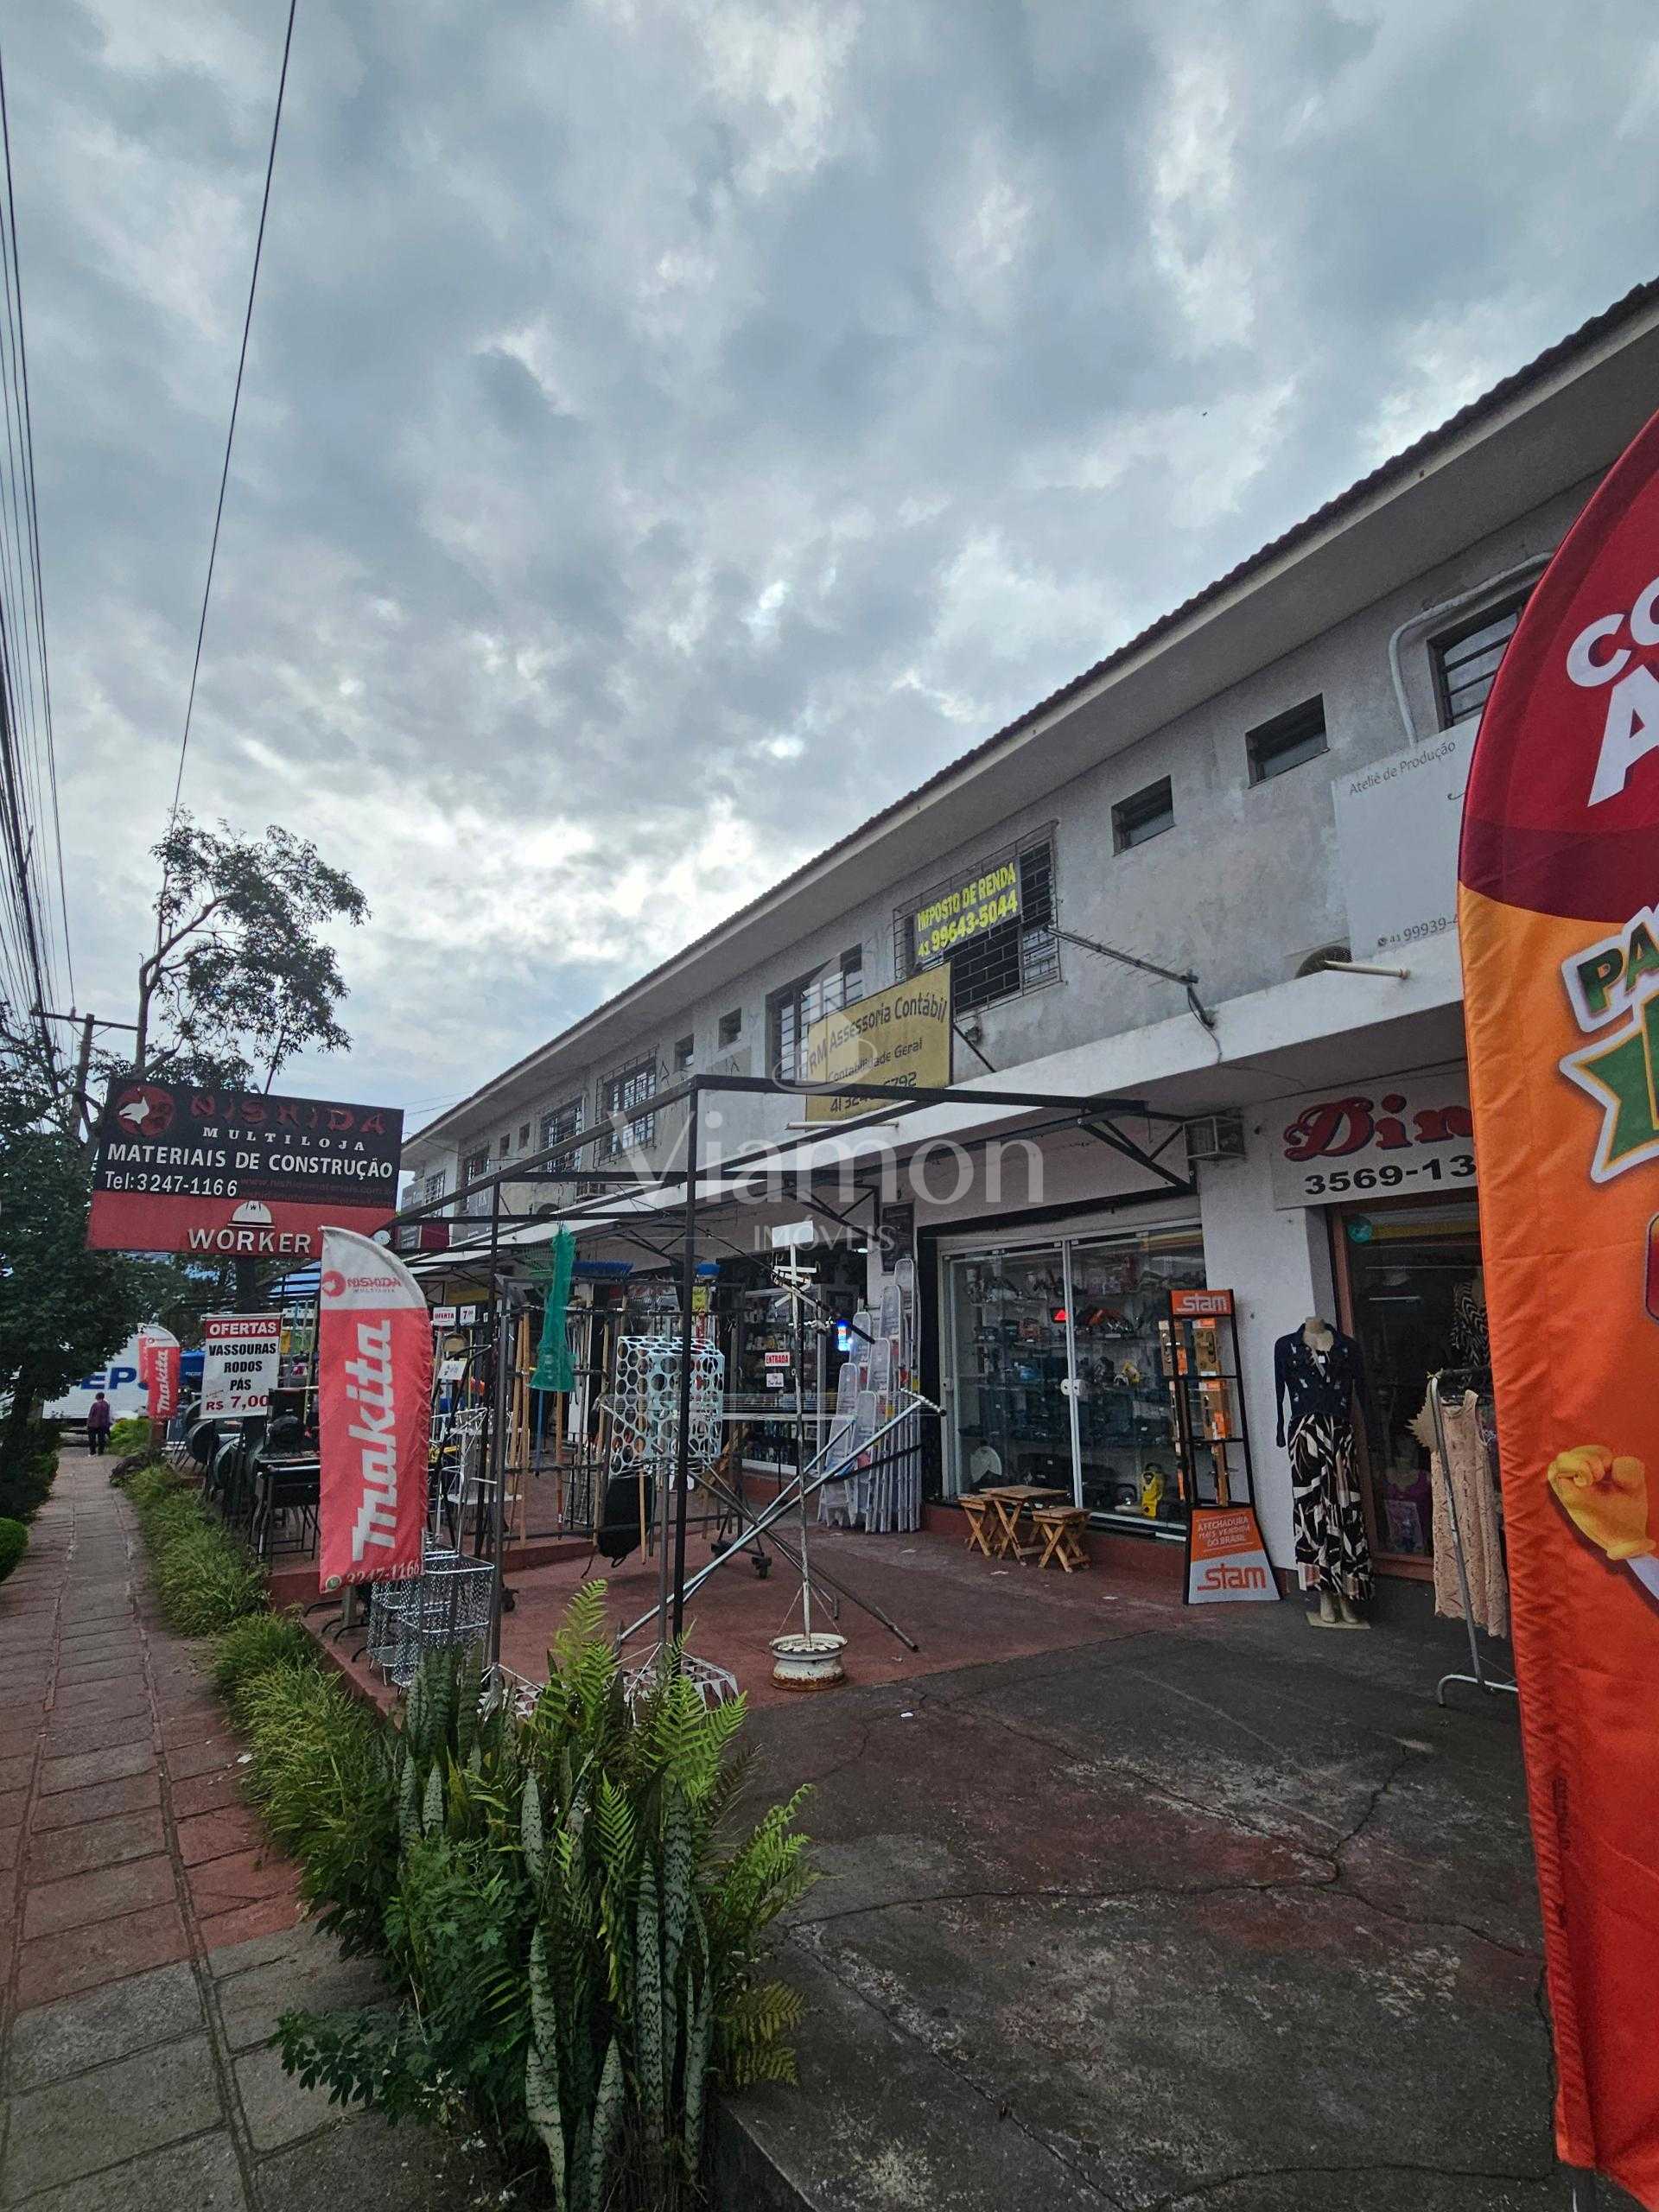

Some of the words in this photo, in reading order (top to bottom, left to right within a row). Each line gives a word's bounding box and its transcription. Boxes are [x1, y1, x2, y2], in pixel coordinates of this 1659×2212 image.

[1383, 766, 1397, 782] de
[1400, 741, 1456, 773] Produção
[917, 892, 961, 932] IMPOSTO
[962, 882, 977, 908] DE
[978, 862, 1016, 900] RENDA
[931, 889, 1018, 952] 99643-5044
[829, 1002, 892, 1052] Assessoria
[894, 992, 948, 1024] Contábil
[190, 1094, 386, 1135] NISHIDA
[203, 1126, 365, 1151] MULTILOJA
[107, 1143, 226, 1168] MATERIAIS
[234, 1151, 259, 1170] DE
[268, 1154, 393, 1180] CONSTRUÇÃO
[1305, 1154, 1477, 1194] 3569-13
[188, 1228, 311, 1254] WORKER
[346, 1277, 402, 1287] NISHIDA
[209, 1322, 276, 1336] OFERTAS
[208, 1343, 276, 1357] VASSOURAS
[766, 1355, 789, 1364] ENTRADA
[224, 1360, 263, 1373] RODOS
[156, 1350, 170, 1414] makita
[230, 1376, 251, 1391] PÁS
[230, 1395, 270, 1410] 7,00
[347, 1319, 397, 1561] makita
[1197, 1562, 1267, 1591] stam
